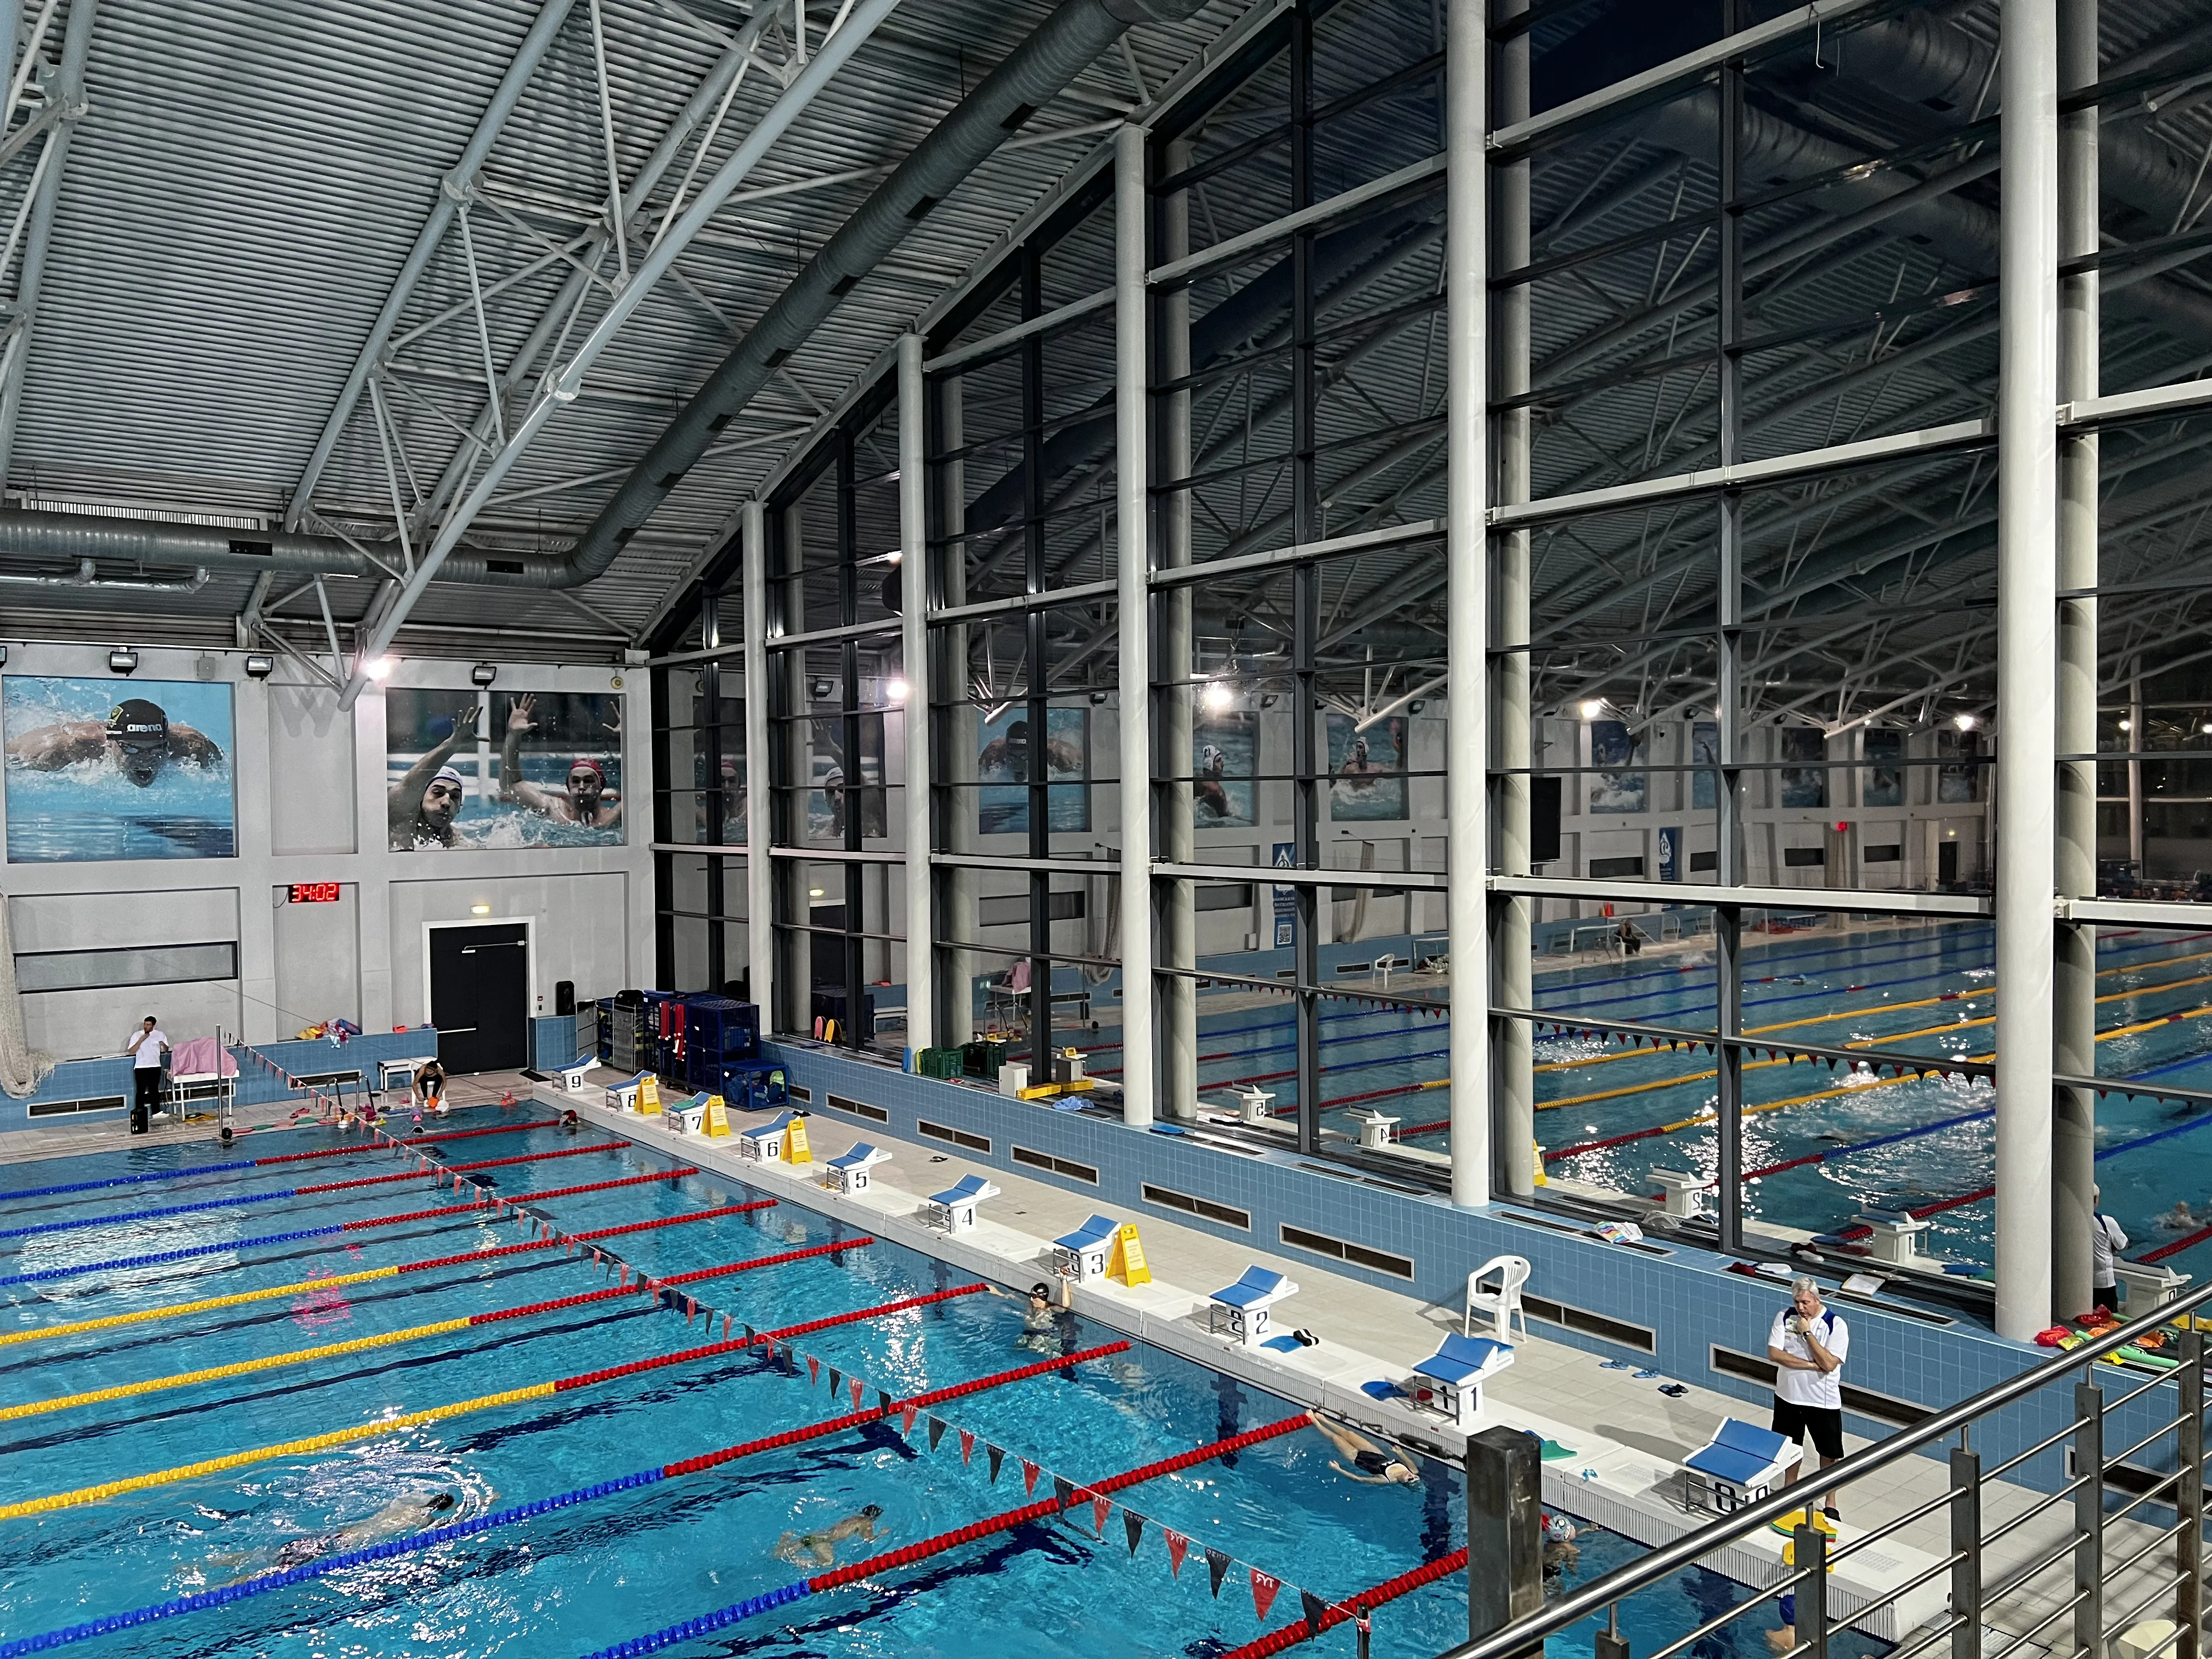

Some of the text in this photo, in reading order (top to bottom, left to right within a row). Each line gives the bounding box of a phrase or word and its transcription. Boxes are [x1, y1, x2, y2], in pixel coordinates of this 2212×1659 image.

[126, 724, 162, 732] arena
[291, 883, 336, 901] 34:02
[572, 1076, 581, 1088] 9
[628, 1094, 636, 1107] 8
[692, 1116, 701, 1130] 7
[768, 1142, 777, 1156] 6
[856, 1171, 867, 1188] 5
[962, 1208, 973, 1225] 4
[1091, 1254, 1104, 1274] 3
[1256, 1311, 1268, 1335] 2
[1440, 1385, 1449, 1410] 1
[1471, 1386, 1477, 1412] 1
